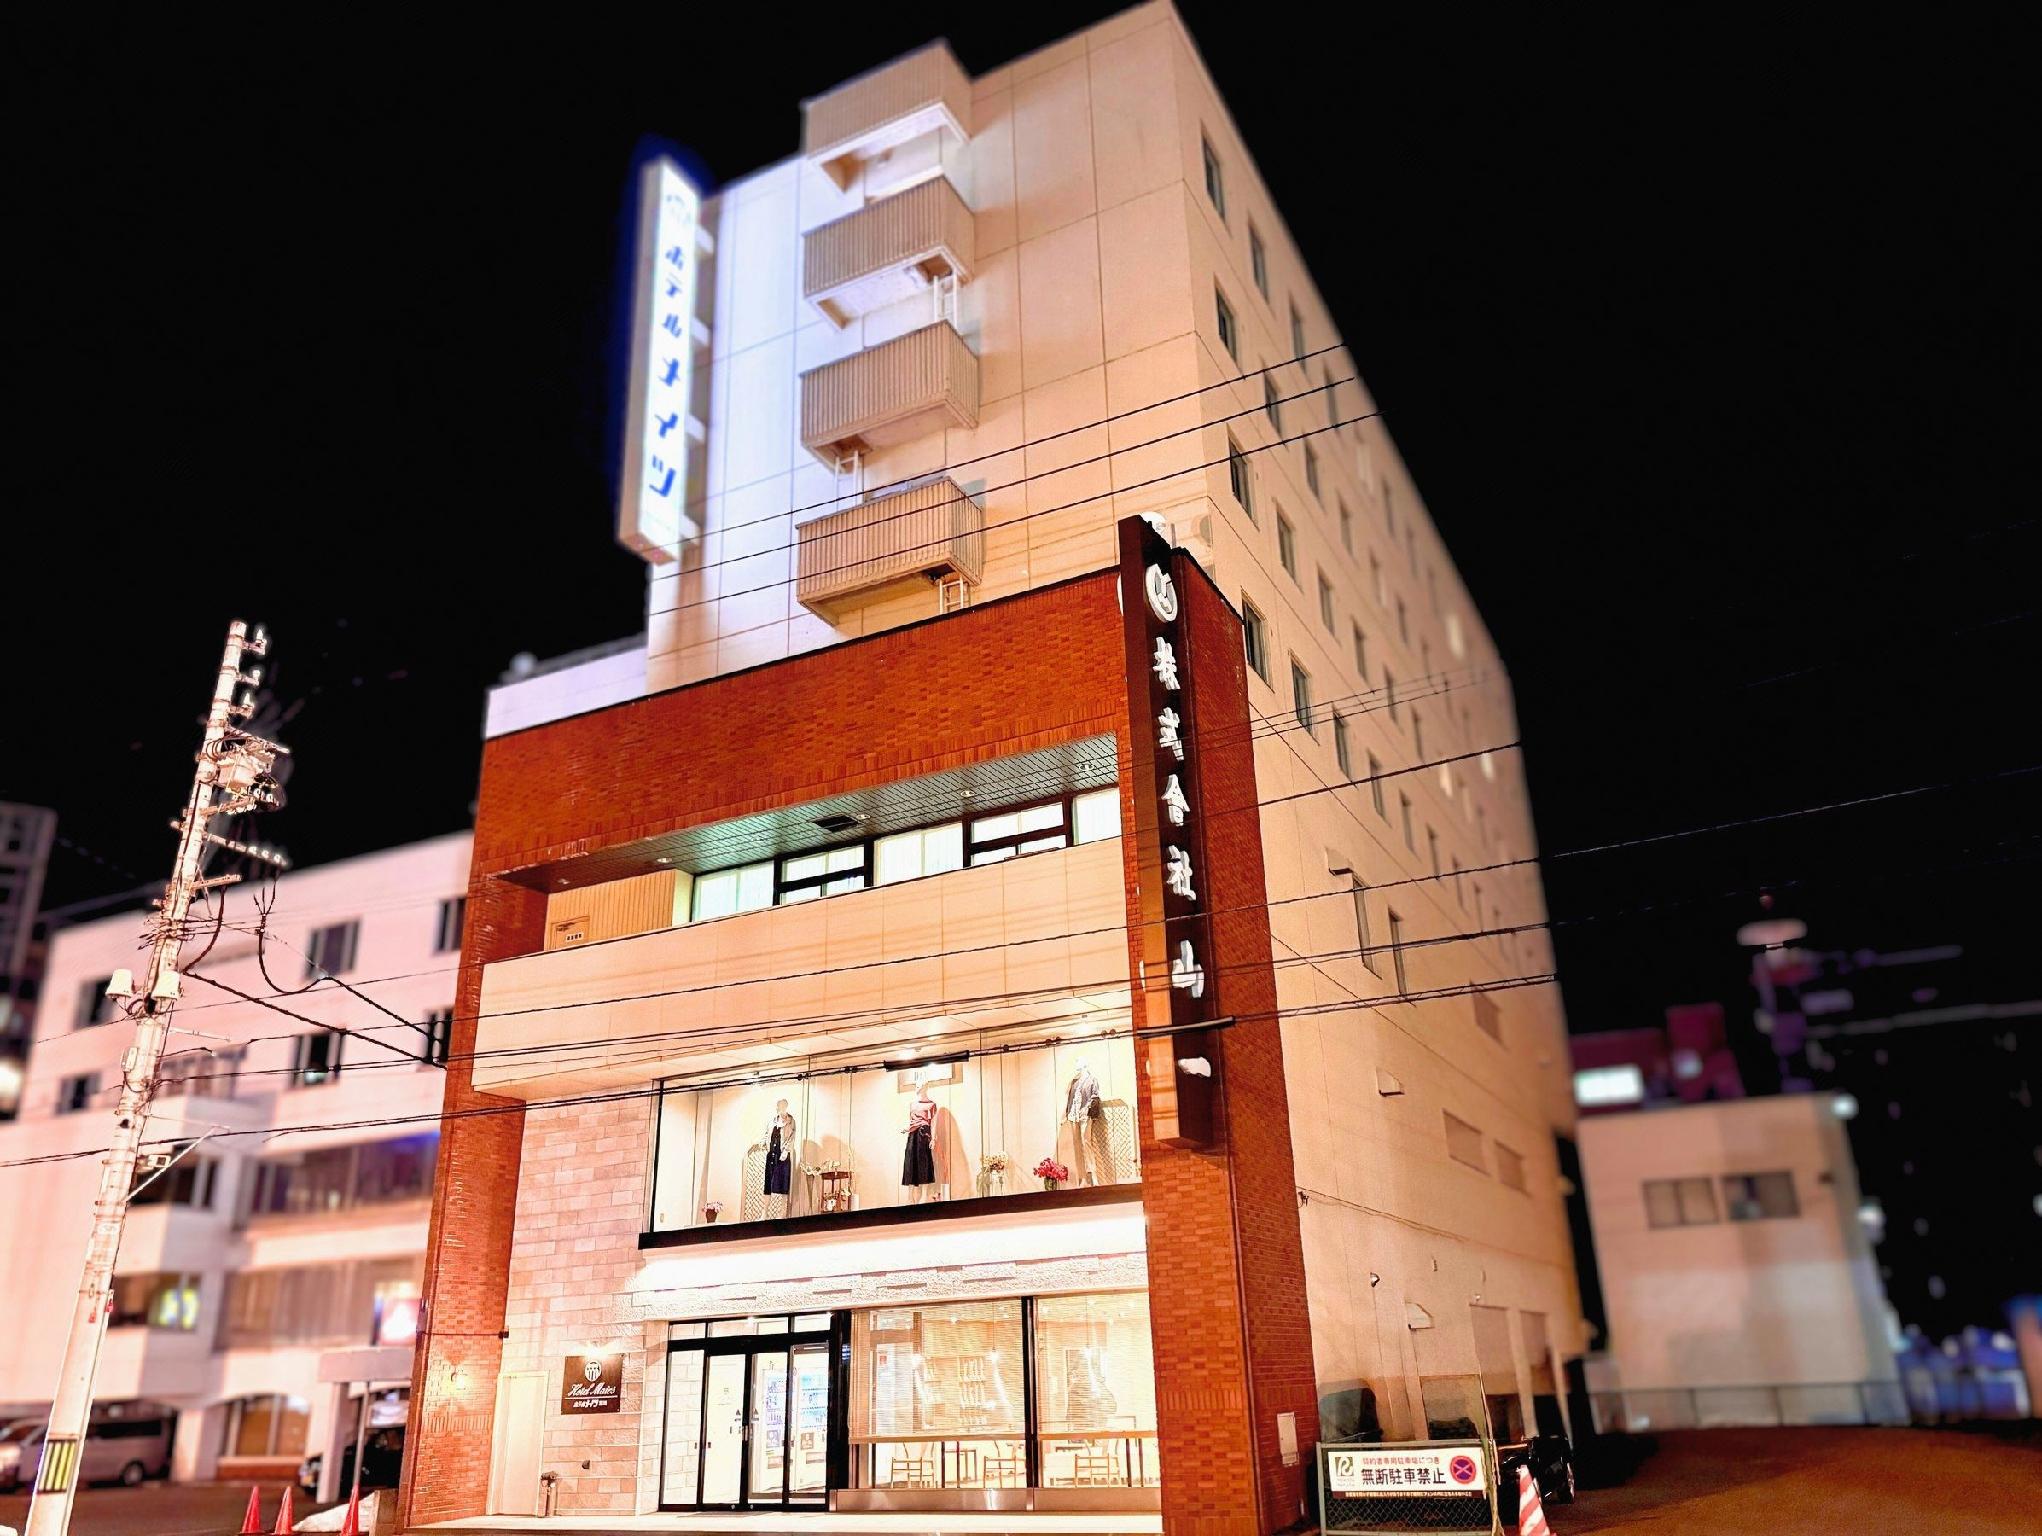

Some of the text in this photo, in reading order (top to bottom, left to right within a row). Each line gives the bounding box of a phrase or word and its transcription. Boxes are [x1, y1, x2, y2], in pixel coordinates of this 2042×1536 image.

[650, 246, 683, 497] ホテルメイツ
[568, 1382, 595, 1396] Hotel
[1361, 1467, 1446, 1485] 無断駐車禁止
